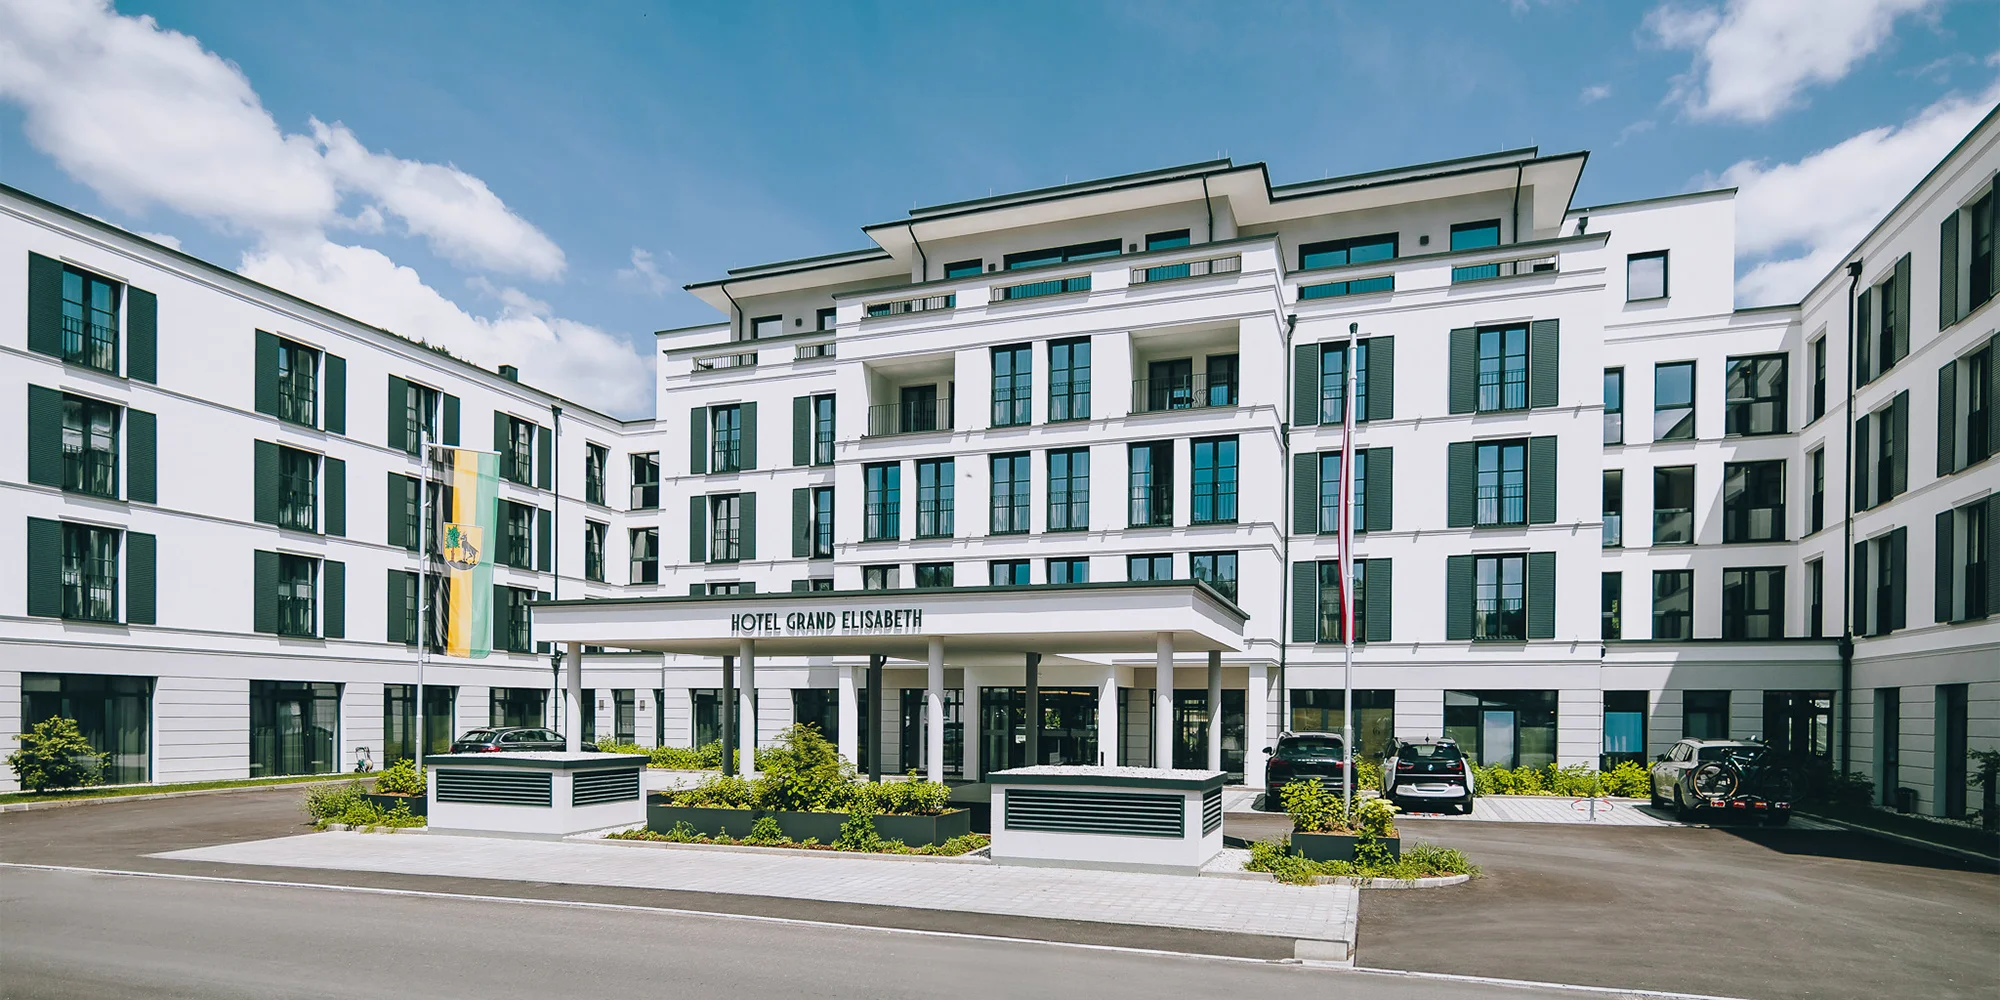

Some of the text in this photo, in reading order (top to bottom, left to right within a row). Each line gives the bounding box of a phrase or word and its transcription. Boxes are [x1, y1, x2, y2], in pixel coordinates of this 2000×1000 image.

[731, 609, 922, 631] HOTEL GRAND ELISABETH
